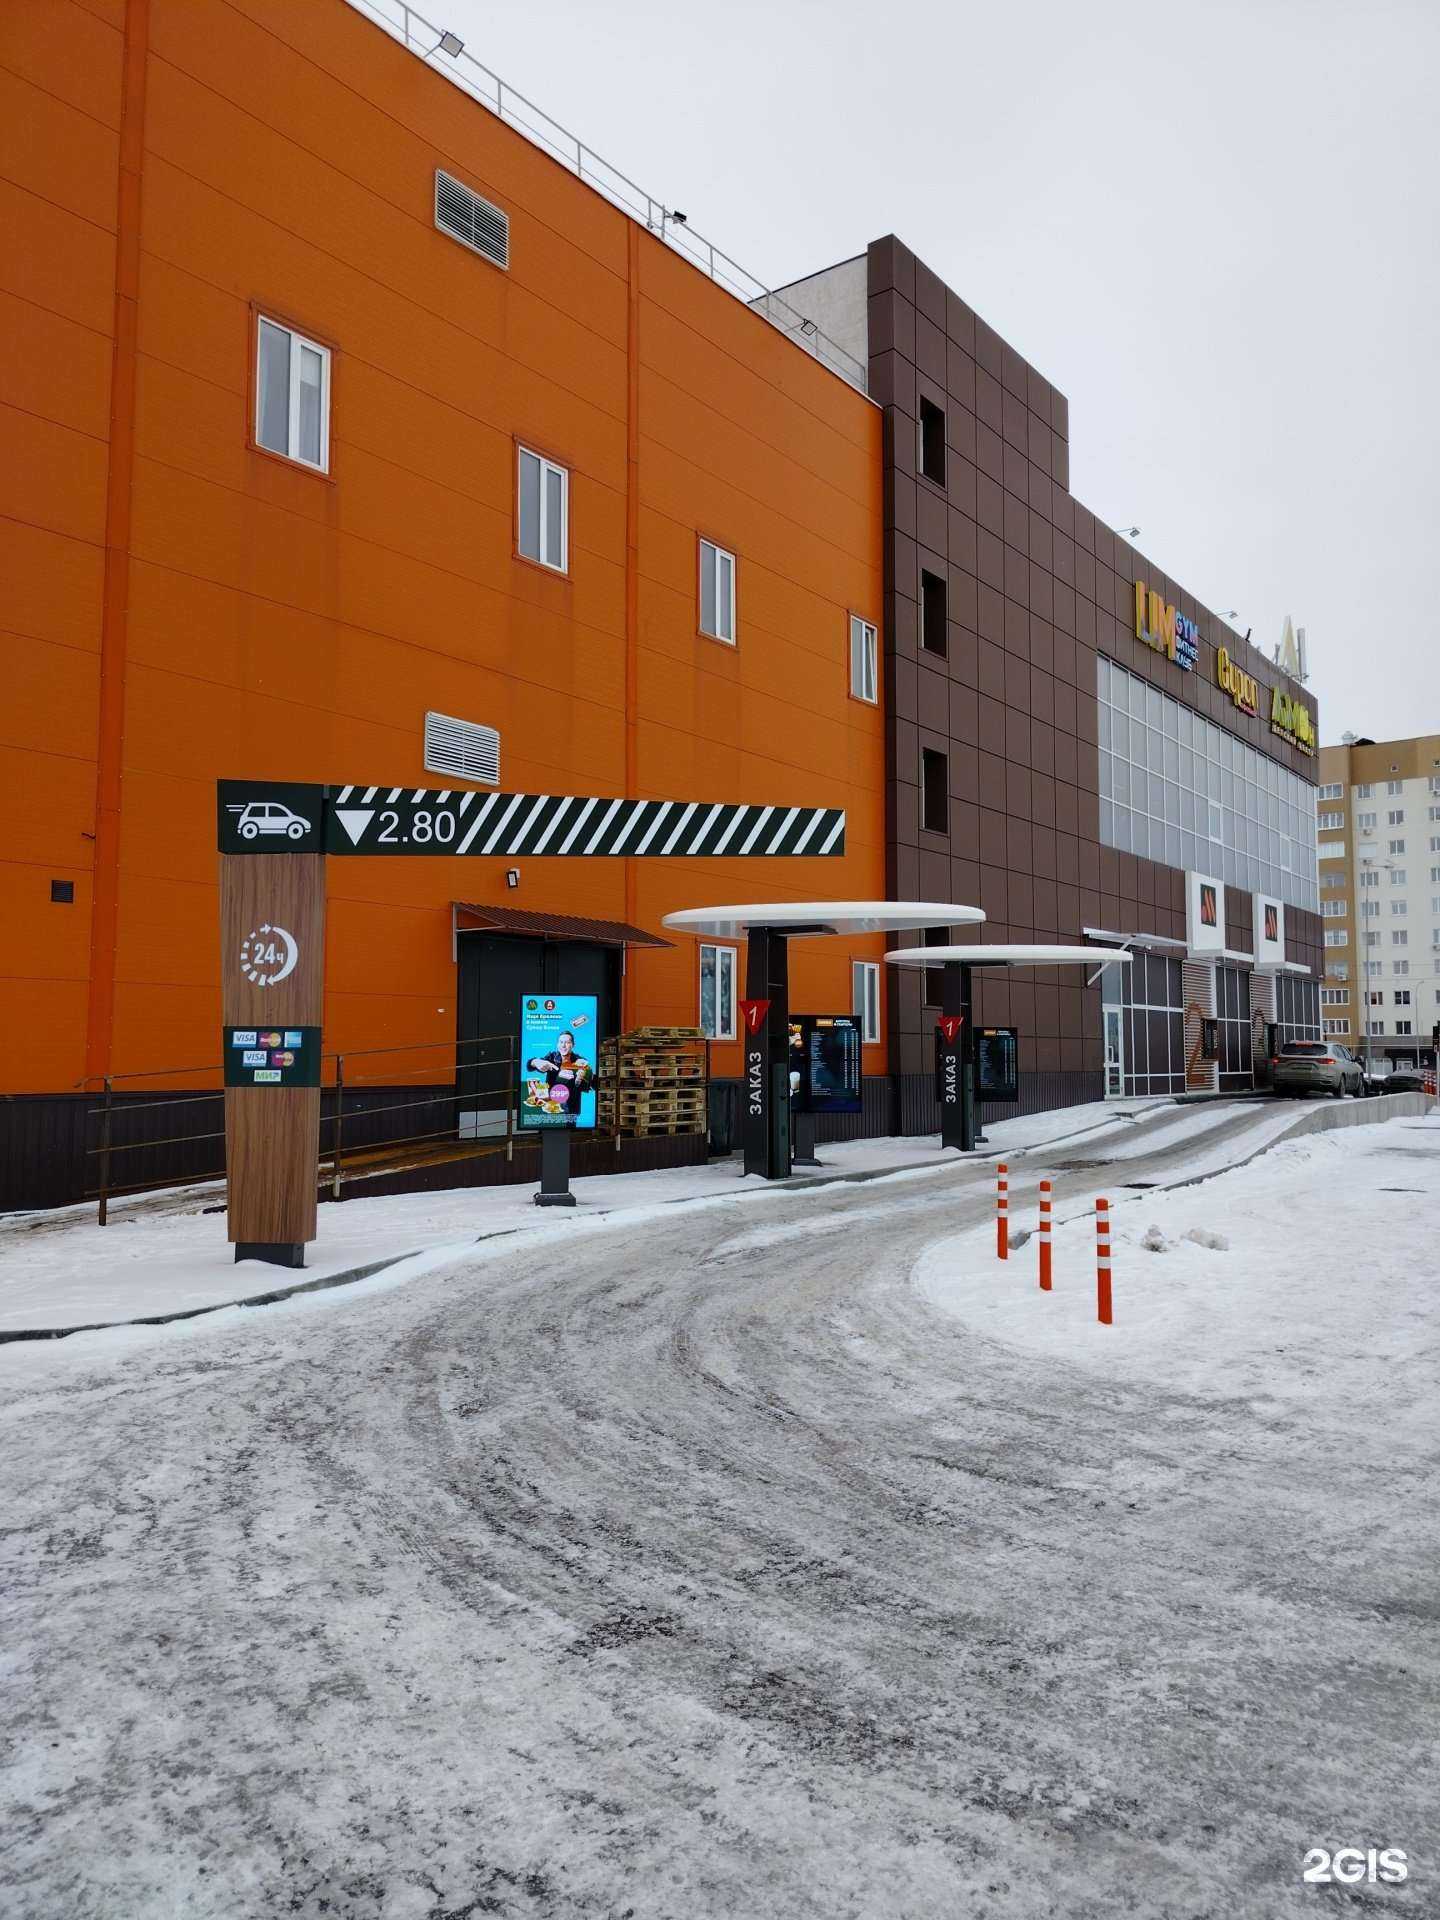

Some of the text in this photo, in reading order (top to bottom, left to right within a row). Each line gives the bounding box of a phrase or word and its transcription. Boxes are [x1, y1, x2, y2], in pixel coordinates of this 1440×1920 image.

[1135, 580, 1199, 660] LIM GYM
[377, 811, 456, 843] 2.80
[749, 1005, 757, 1026] 1
[236, 1033, 255, 1042] VISA
[246, 1053, 266, 1062] VISA
[255, 1071, 280, 1080] МИР
[749, 1052, 762, 1115] ЗАКАЗ
[945, 1055, 957, 1103] ЗАКАЗ
